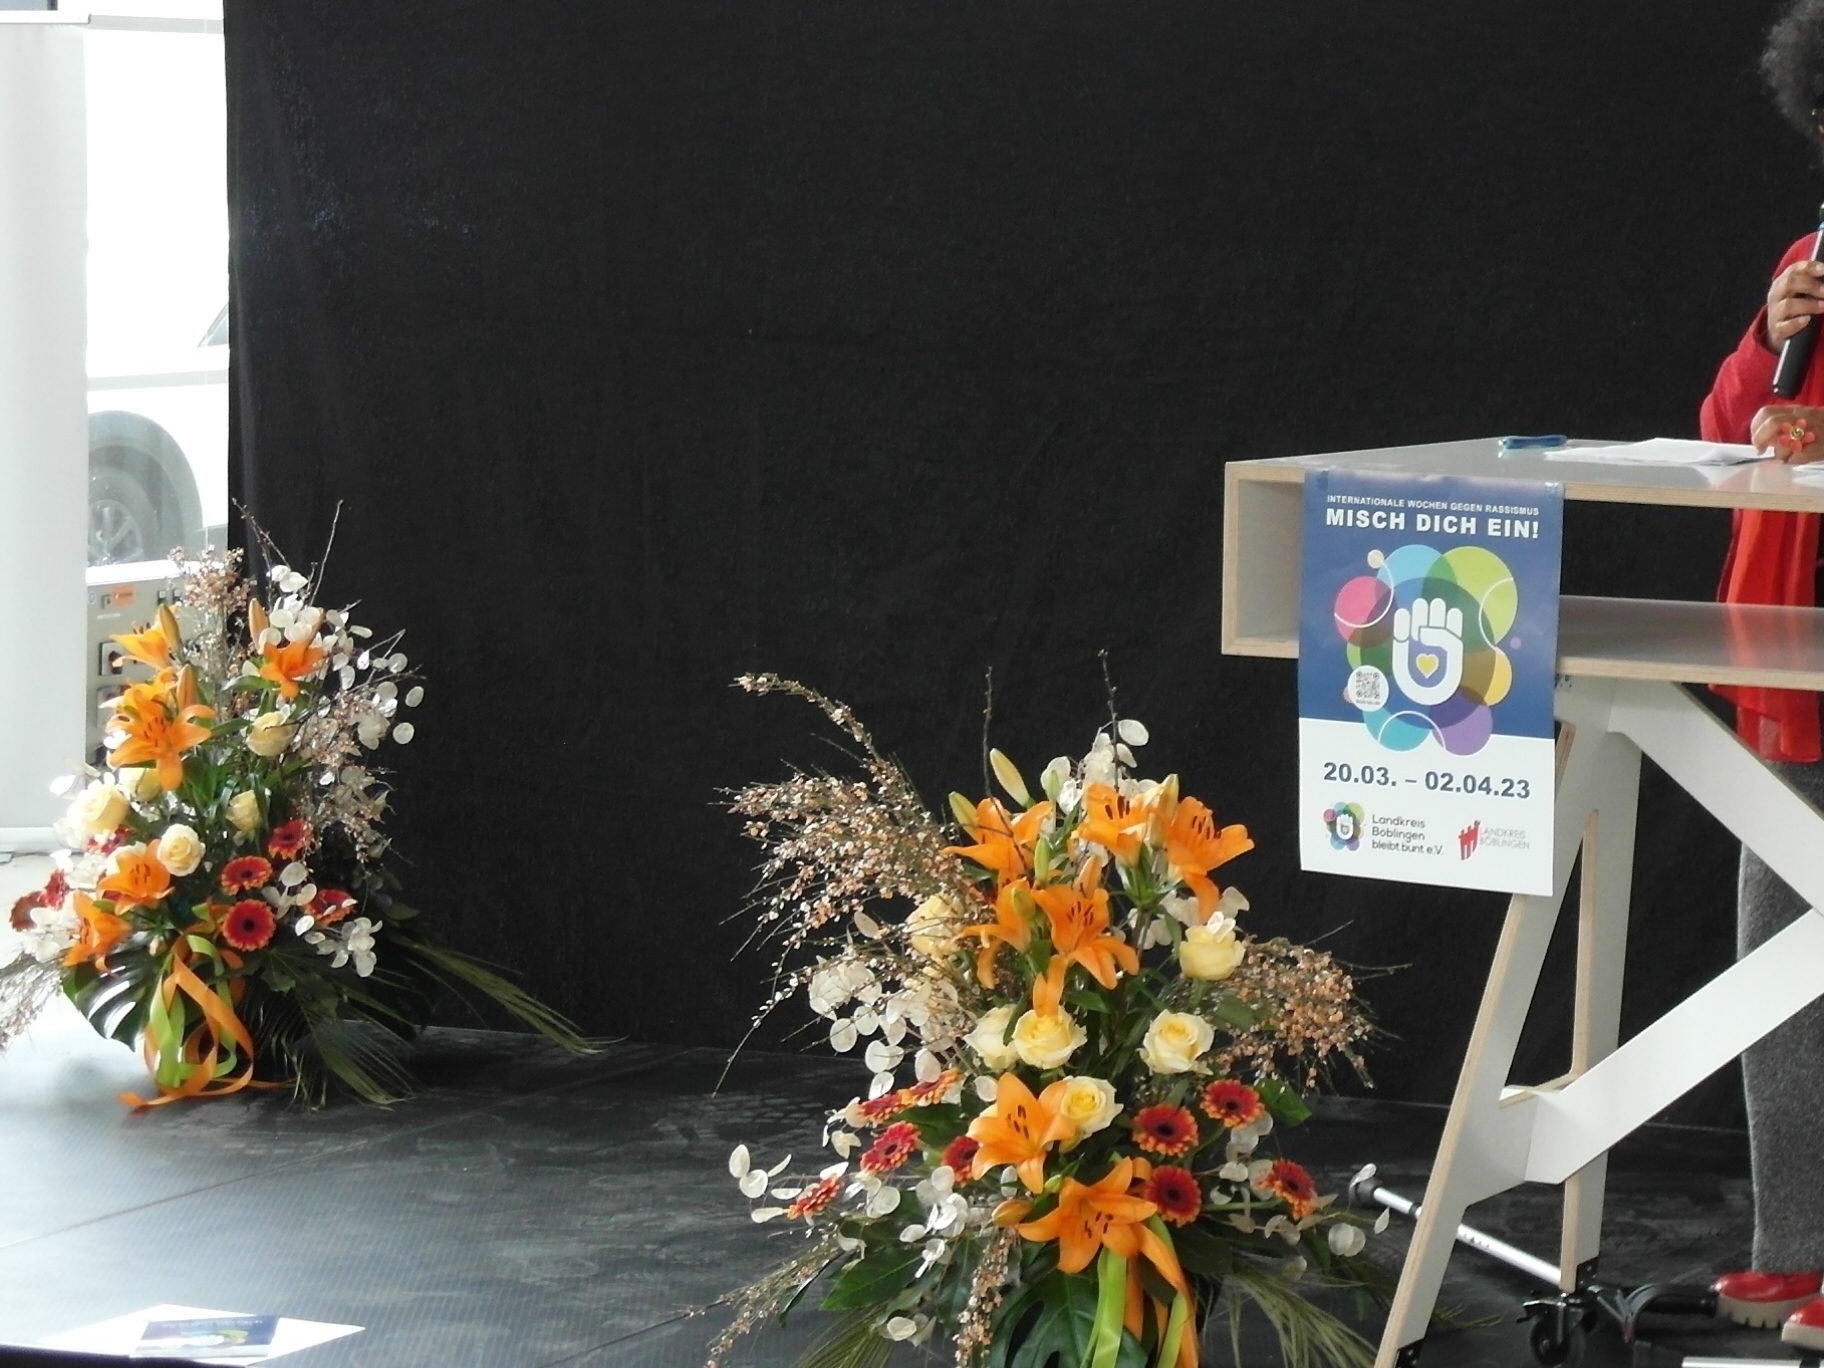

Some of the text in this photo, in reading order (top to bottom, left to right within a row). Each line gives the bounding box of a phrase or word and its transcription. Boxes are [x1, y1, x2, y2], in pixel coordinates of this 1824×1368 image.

[1327, 495, 1540, 516] INTERNATIONALE WOCHEN GEGEN RASSISMUS
[1326, 508, 1539, 539] MISCH DICH EIN!
[1323, 762, 1397, 787] 20.03.
[1425, 771, 1530, 799] 02.04.23
[1372, 814, 1426, 829] Landkreis
[1372, 826, 1425, 843] Böblingen
[1371, 838, 1444, 856] bleibt bunt e.V.
